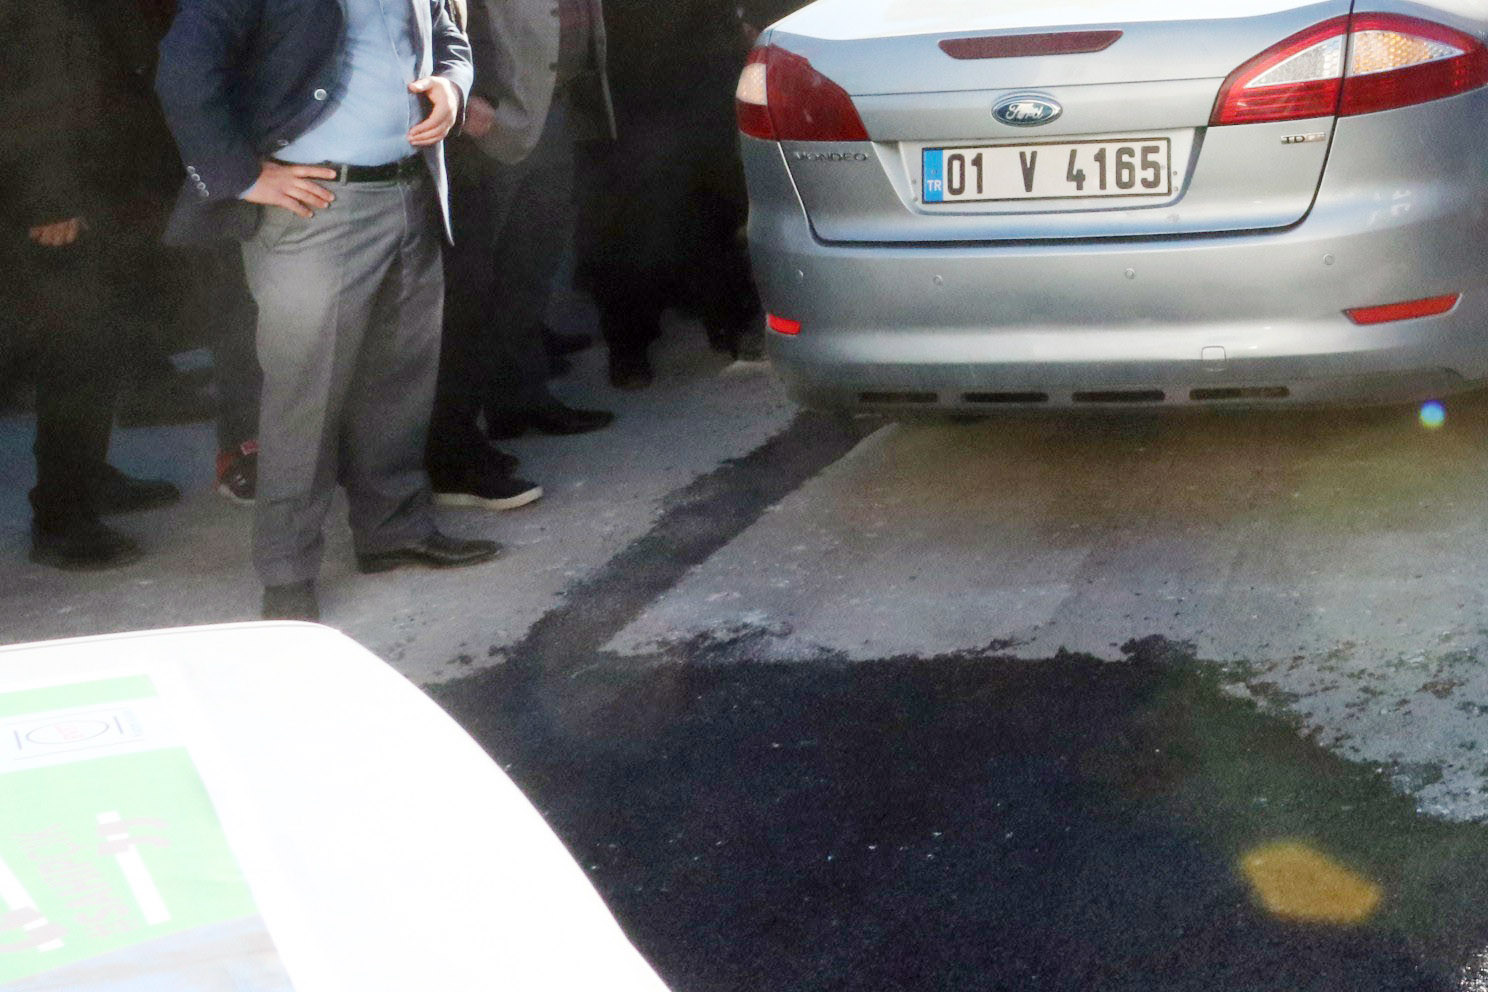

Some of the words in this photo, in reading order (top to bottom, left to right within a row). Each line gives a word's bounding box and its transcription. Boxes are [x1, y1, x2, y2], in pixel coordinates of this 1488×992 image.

[1005, 102, 1044, 120] Ford
[947, 152, 984, 196] 01
[1019, 150, 1038, 193] V
[1066, 145, 1161, 191] 4165
[927, 179, 942, 192] TR
